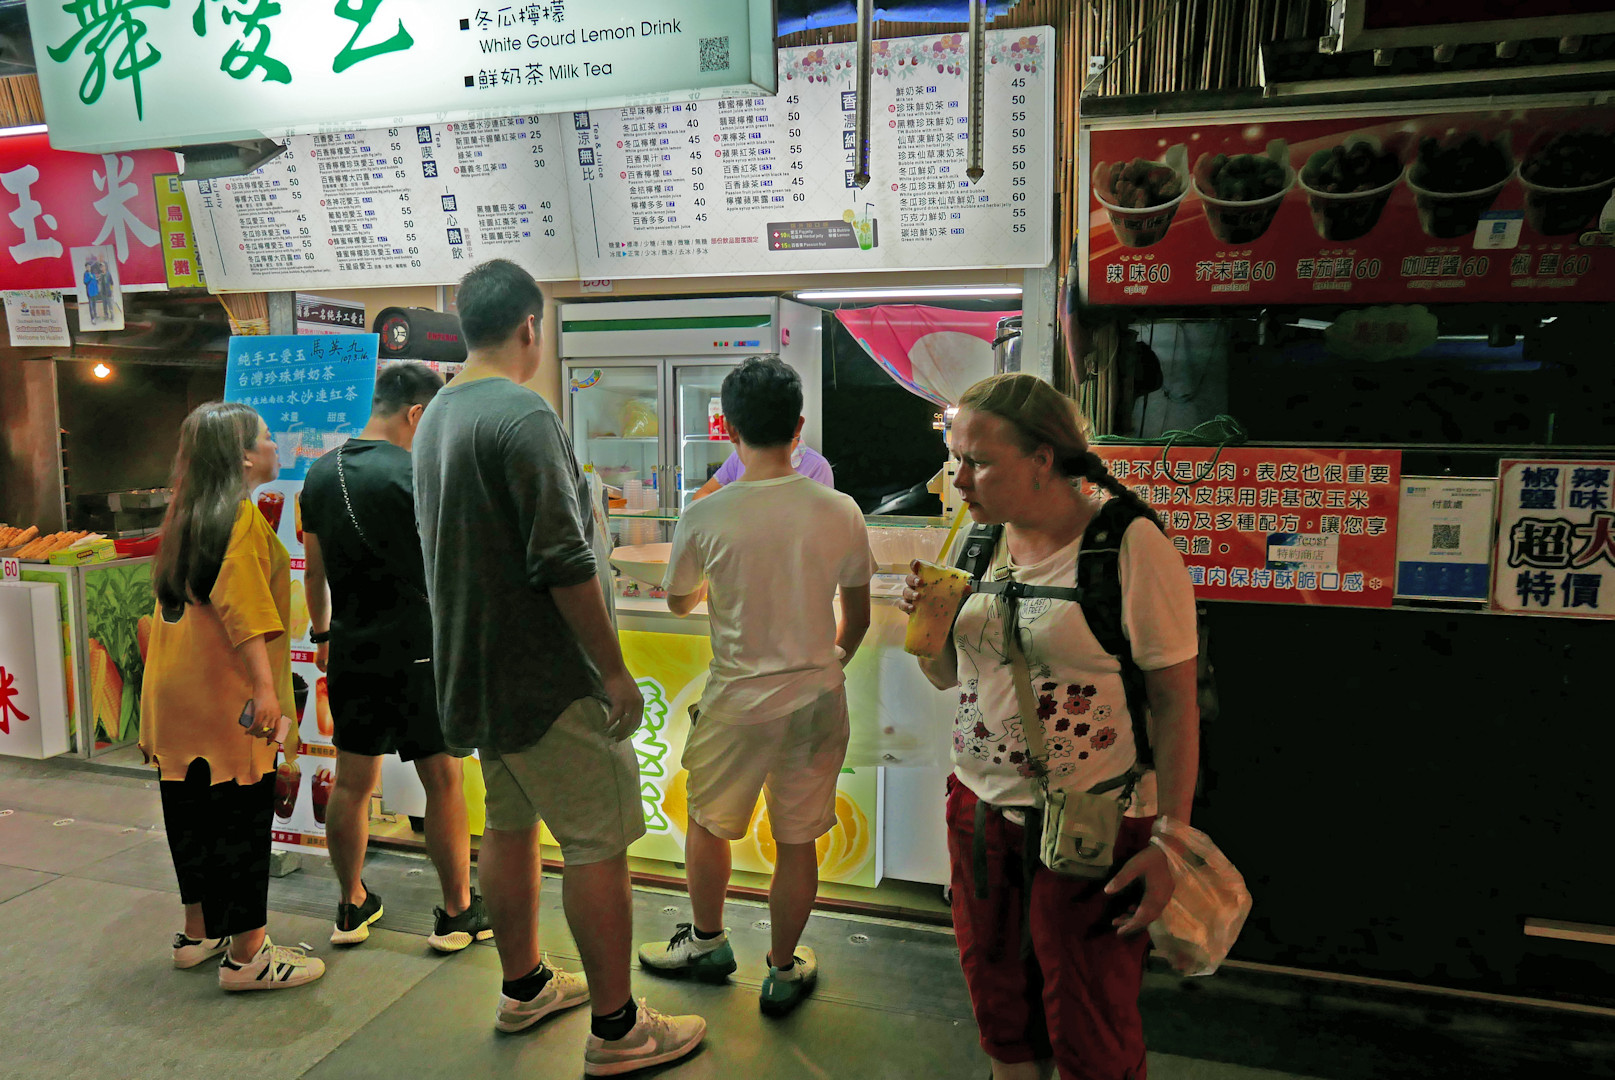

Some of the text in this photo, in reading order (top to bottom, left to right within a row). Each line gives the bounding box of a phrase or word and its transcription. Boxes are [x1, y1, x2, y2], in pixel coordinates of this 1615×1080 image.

[474, 1, 565, 31] 冬瓜檸檬
[479, 18, 682, 54] White Gourd Lemon Drink
[478, 61, 613, 90] 鮮奶茶 Milk Tea
[896, 78, 1026, 96] 鮮奶茶 45
[718, 95, 799, 109] 蜂蜜檸檬 45
[896, 95, 1026, 112] 珍珠鮮奶茶 50
[621, 103, 697, 117] 古早味檸檬汁 40
[528, 116, 539, 124] 30
[623, 119, 699, 132] 冬瓜紅茶 40
[719, 112, 800, 126] 翡翠檸檬 50
[897, 112, 1026, 129] 黑糖珍珠鮮奶 55
[282, 138, 291, 146] 45
[530, 131, 541, 139] 25
[624, 136, 700, 148] 冬瓜檸檬 45
[721, 128, 801, 142] 凍檸茶 50
[898, 128, 1026, 145] 仙草凍鮮奶茶 50
[574, 111, 595, 181] 清涼無比
[722, 145, 802, 158] 蘋果紅茶 55
[898, 145, 1026, 160] 珍珠仙草凍奶茶 55
[535, 160, 545, 168] 30
[626, 152, 702, 164] 百香果汁 45
[628, 167, 703, 180] 百香檸檬 50
[723, 161, 803, 174] 百香紅茶 45
[899, 161, 1026, 176] 冬瓜鮮奶 50
[630, 183, 704, 195] 金桔檸檬 50
[725, 177, 804, 190] 百香綠茶 45
[900, 177, 1026, 191] 冬瓜珍珠鮮奶 55
[631, 198, 706, 210] 檸檬多多 40
[793, 193, 805, 201] 60
[900, 193, 1026, 207] 冬瓜珍珠仙草鮮奶 60
[0, 153, 164, 265] 玉米
[401, 207, 411, 215] 55
[540, 201, 551, 209] 40
[542, 215, 553, 223] 40
[633, 217, 665, 225] 百香多多
[901, 208, 1026, 222] 巧克力鮮奶 55
[404, 220, 414, 228] 50
[1012, 224, 1026, 233] 55
[302, 240, 311, 248] 55
[1123, 284, 1149, 295] spicy
[310, 339, 364, 359] 馬英九
[237, 349, 306, 367] 純手工愛玉
[238, 365, 335, 387] 台灣珍珠鮮奶茶
[281, 411, 347, 423] 冰量 甜度
[1100, 459, 1391, 485] 排不只是吃肉，表皮也很重要
[1519, 466, 1559, 510] 椒鹽
[1569, 466, 1611, 510] 辣味
[4, 559, 18, 577] 60
[1516, 570, 1603, 609] 特價
